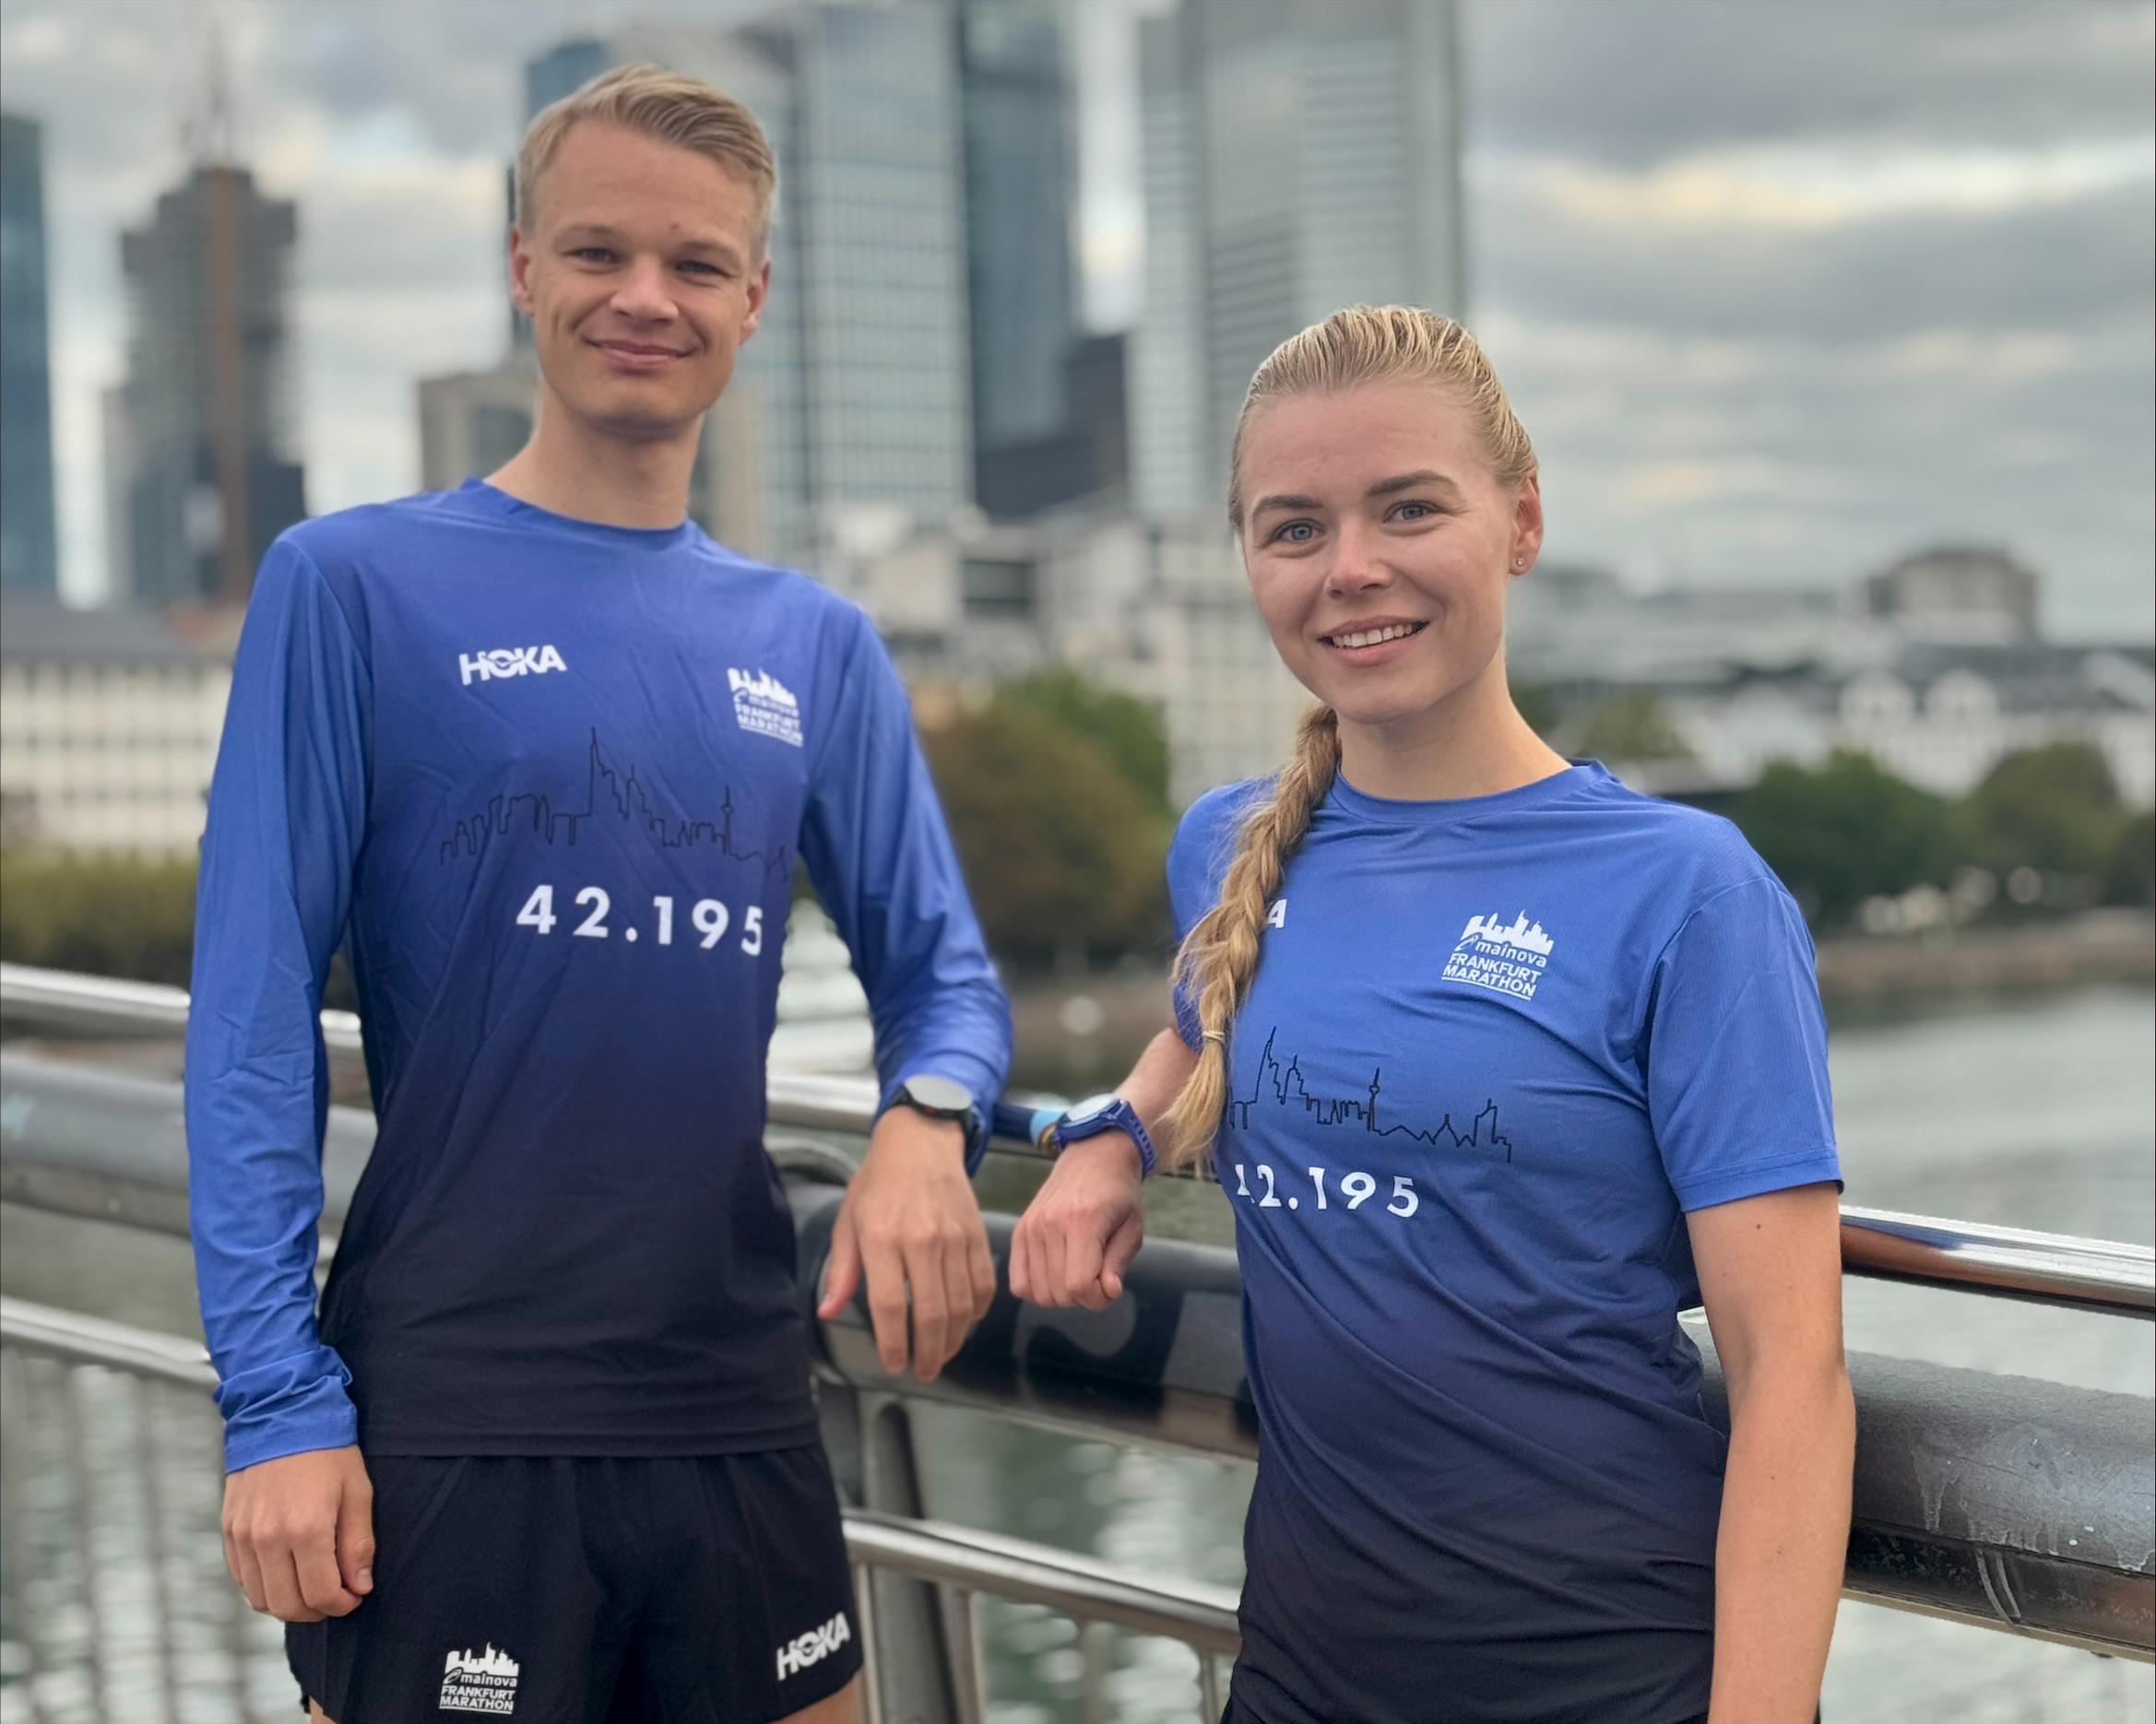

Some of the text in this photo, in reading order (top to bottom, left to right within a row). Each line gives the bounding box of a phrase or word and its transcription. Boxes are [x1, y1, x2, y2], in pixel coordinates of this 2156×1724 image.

[459, 644, 568, 686] HOKA
[516, 884, 764, 956] 42.195
[1447, 952, 1543, 984] FRANKFURT
[1475, 940, 1548, 968] mainova
[1441, 964, 1537, 997] MARATHON
[776, 1612, 851, 1681] HOKA
[441, 1685, 516, 1701] FRANKFURT
[460, 1672, 518, 1687] mainova
[440, 1695, 515, 1711] MARATHON
